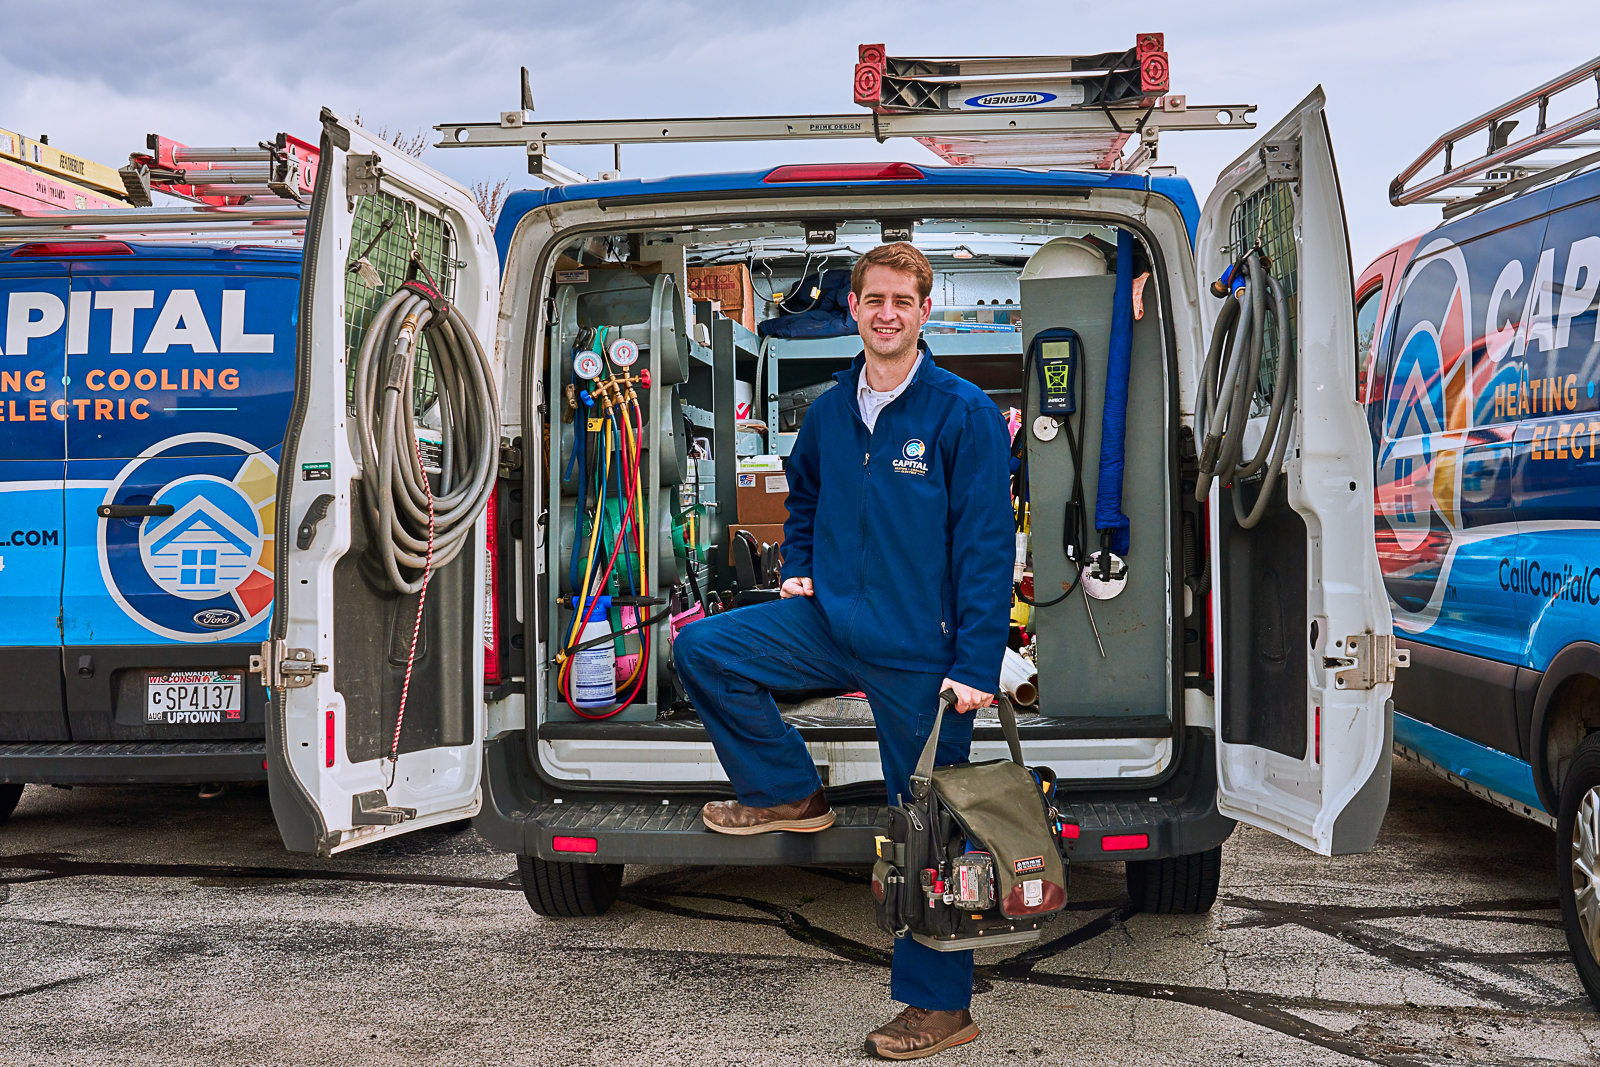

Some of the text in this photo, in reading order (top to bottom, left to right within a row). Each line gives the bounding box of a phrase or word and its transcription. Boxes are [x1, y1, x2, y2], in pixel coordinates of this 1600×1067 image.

[981, 94, 1037, 105] WERNER
[1485, 235, 1600, 363] CAP
[0, 289, 275, 356] PITAL
[85, 368, 240, 392] COOLING
[1494, 374, 1577, 418] HEATING
[1531, 422, 1600, 460] ELECT
[892, 459, 929, 472] CAPITAL
[0, 530, 58, 546] .COM
[203, 613, 230, 624] Ford
[149, 676, 201, 684] WISCONSIN
[153, 685, 234, 710] C SP4137
[148, 712, 162, 720] AUG
[167, 711, 221, 724] UPTOWN
